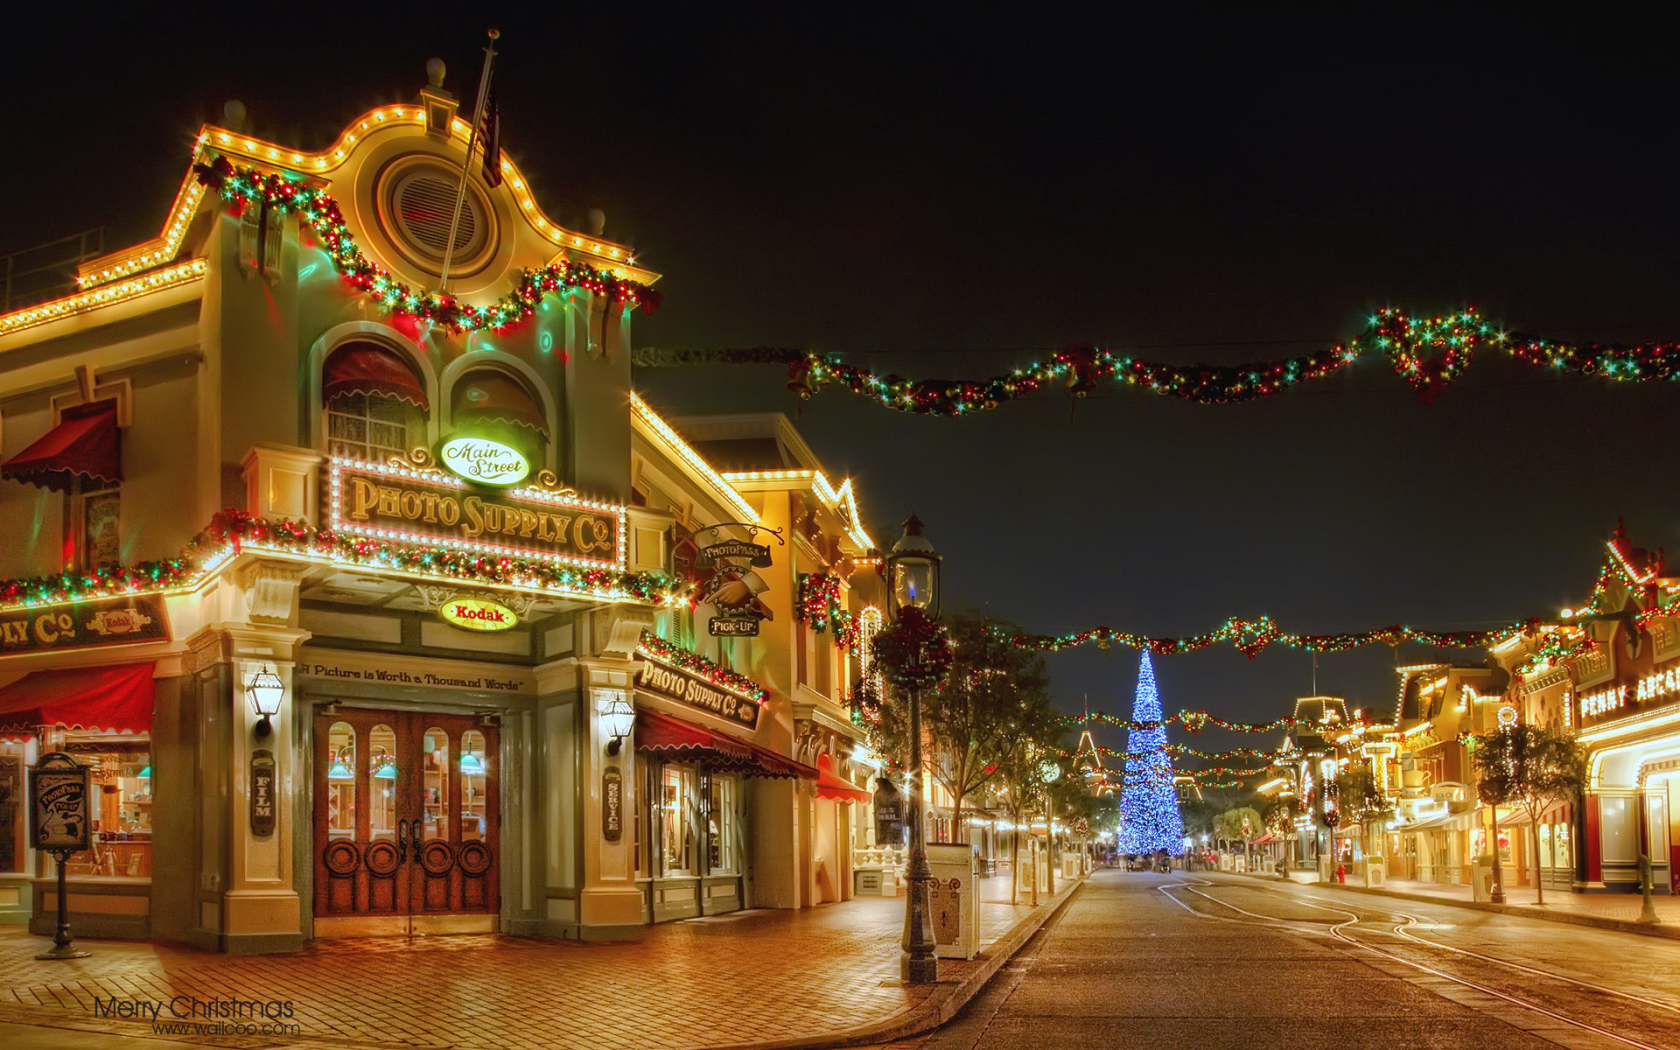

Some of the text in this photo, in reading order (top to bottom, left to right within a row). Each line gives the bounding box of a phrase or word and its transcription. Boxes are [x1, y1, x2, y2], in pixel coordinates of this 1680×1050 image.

[447, 442, 512, 462] Main
[468, 460, 521, 479] Street
[351, 476, 460, 526] PHOTO
[461, 496, 571, 544] SUPPLY
[706, 545, 759, 557] PHOTOPASS
[106, 615, 130, 627] Kodak
[456, 605, 504, 622] Kodak
[0, 620, 28, 643] LY
[714, 621, 753, 632] PICK-UP
[314, 665, 361, 679] Picture
[364, 668, 374, 680] is
[376, 670, 411, 683] Worth
[414, 675, 422, 683] a
[424, 674, 481, 688] Thousand
[640, 659, 686, 694] PHOTO
[685, 681, 724, 711] SUPPLY
[1581, 685, 1627, 718] PENNY
[256, 776, 271, 816] FILM
[608, 783, 618, 830] SERVICE
